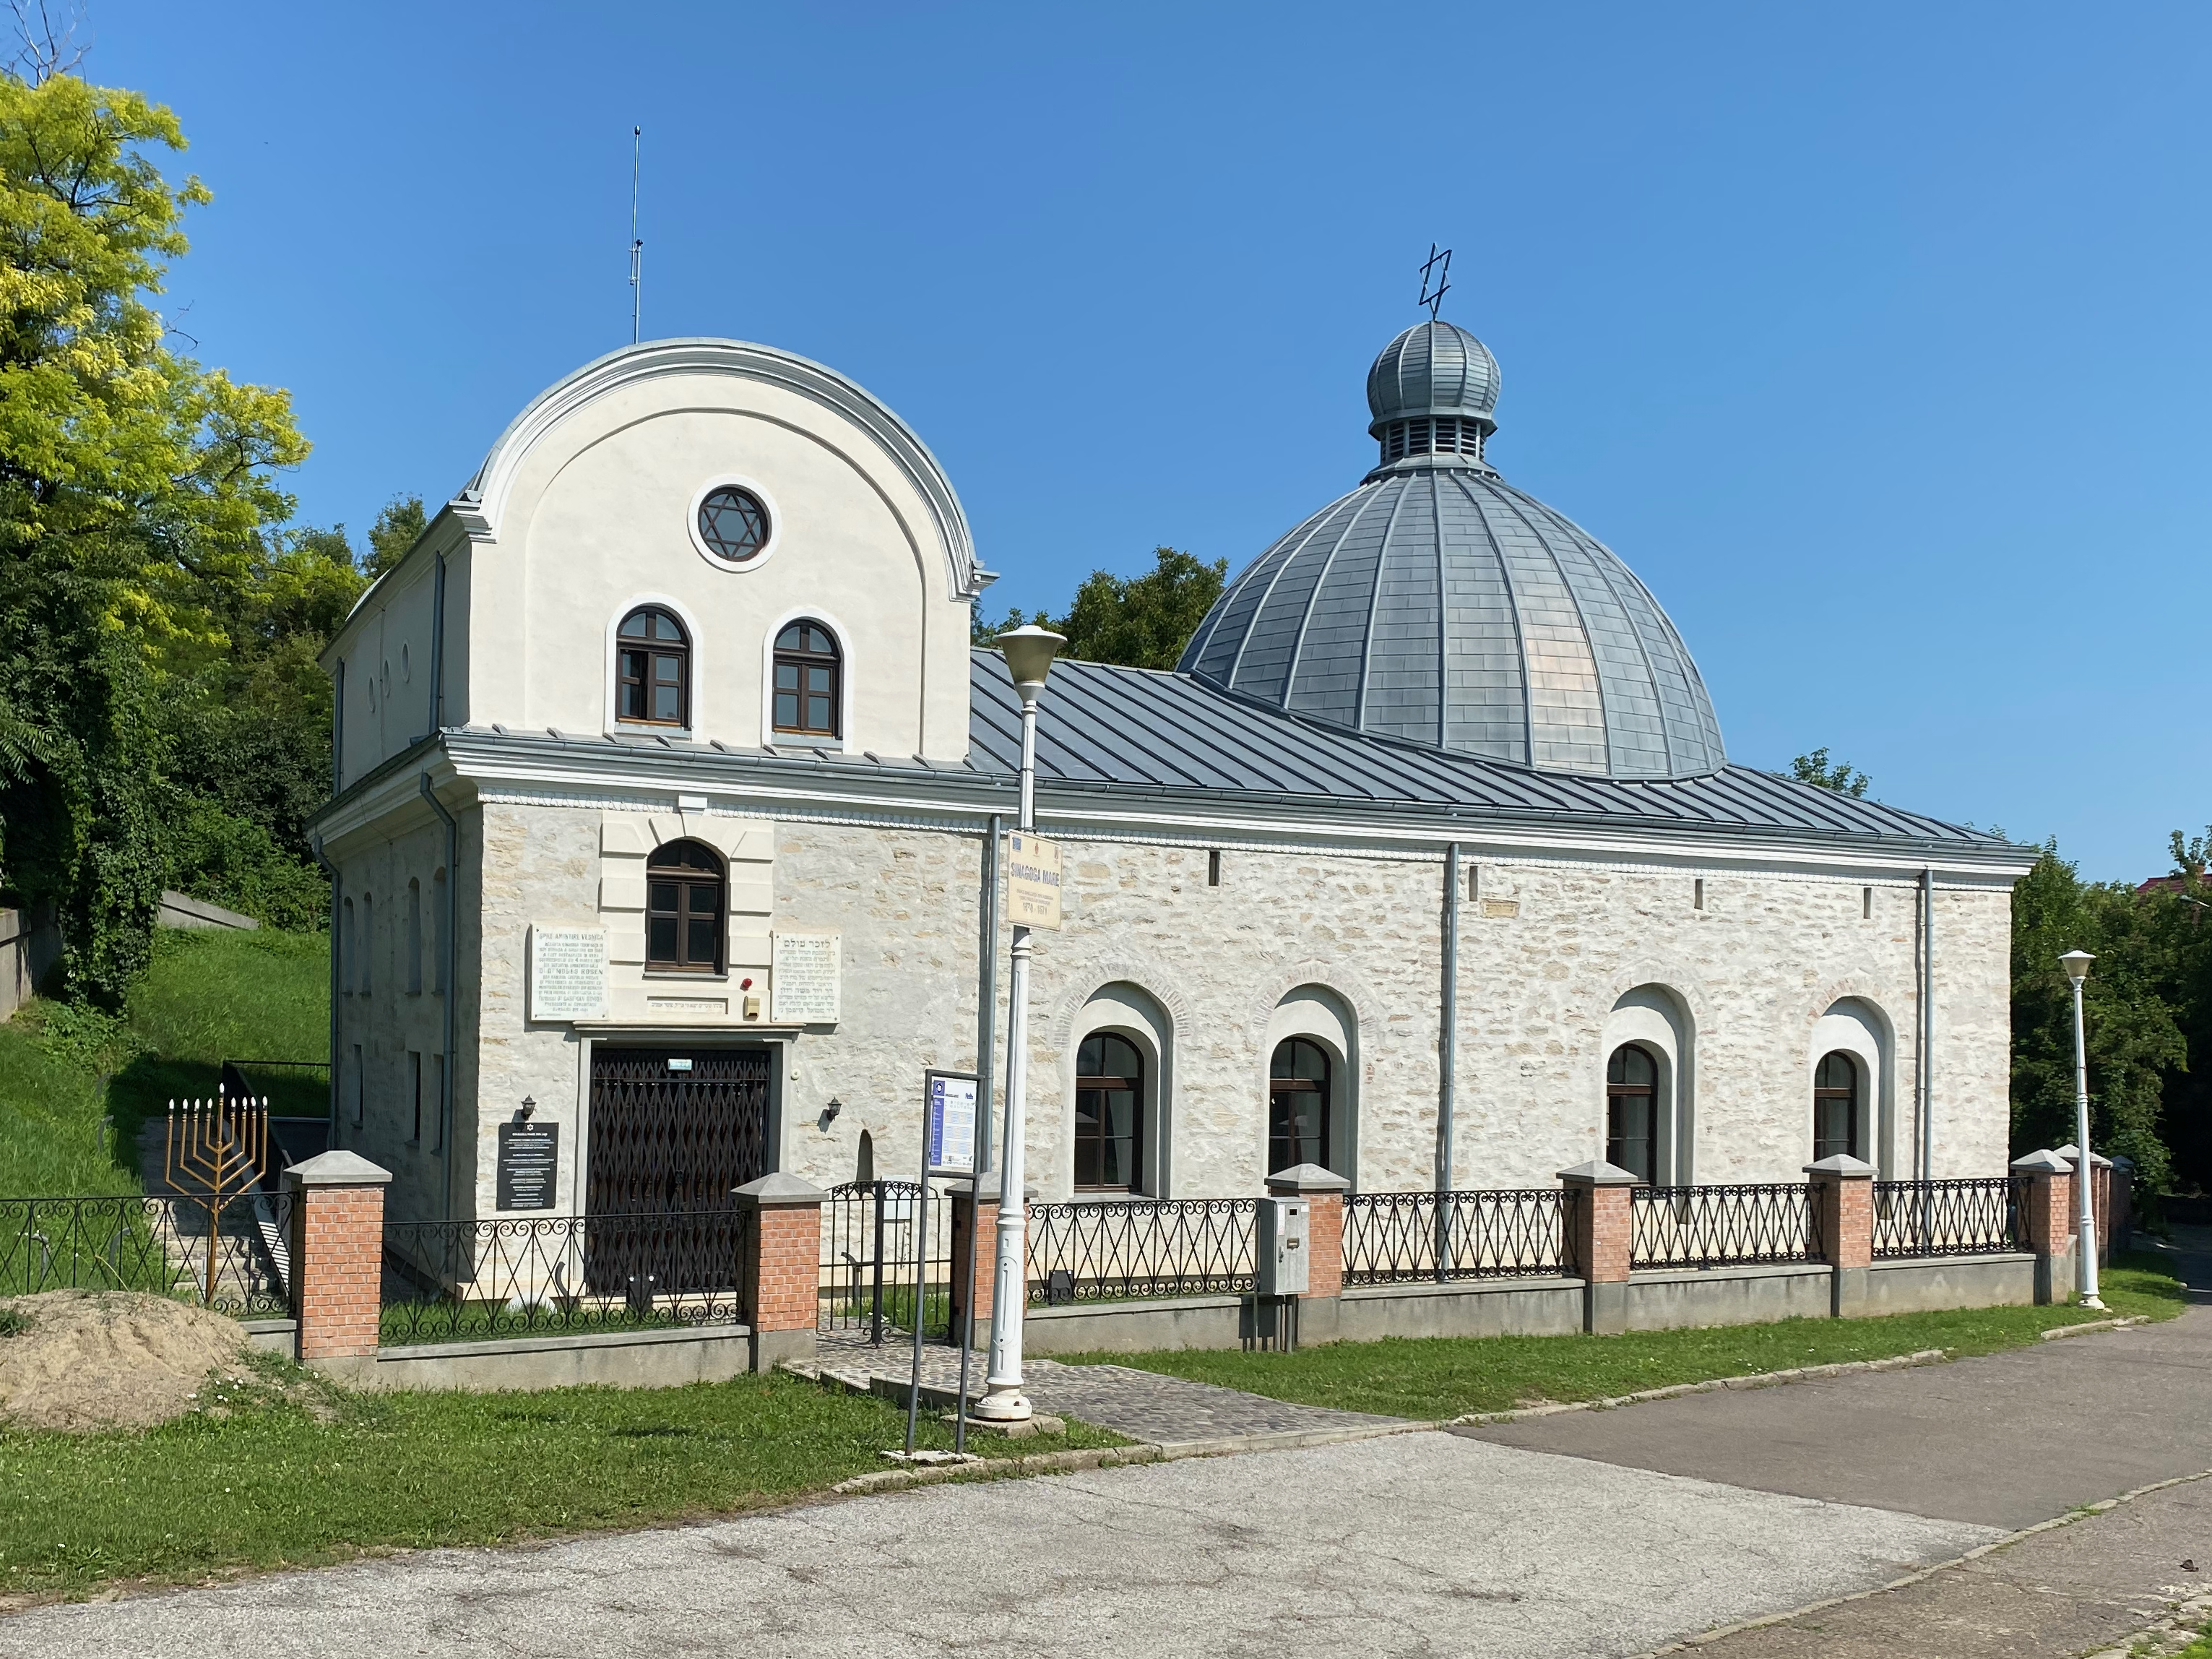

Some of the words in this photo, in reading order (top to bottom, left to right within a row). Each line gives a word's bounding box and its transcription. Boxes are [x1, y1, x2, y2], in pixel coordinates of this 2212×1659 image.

[1011, 862, 1041, 882] SINAGOGA
[1042, 869, 1060, 887] MARE
[784, 938, 805, 948] עולם
[808, 939, 831, 948] לזכר
